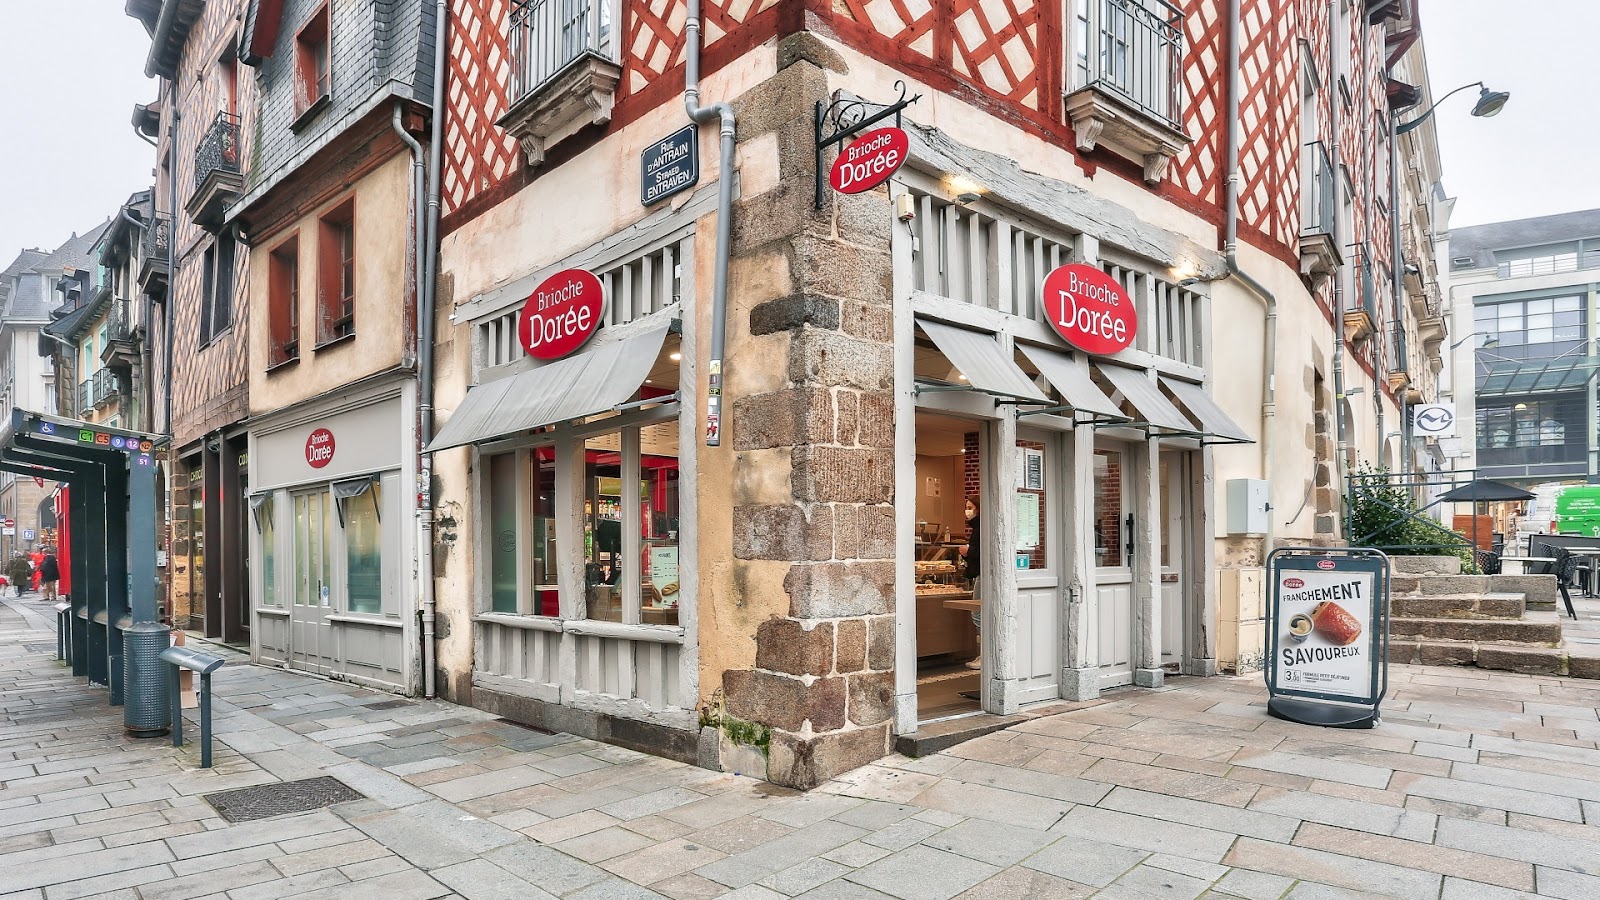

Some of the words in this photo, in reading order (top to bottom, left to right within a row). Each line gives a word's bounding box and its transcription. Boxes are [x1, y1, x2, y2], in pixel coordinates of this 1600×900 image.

[647, 142, 688, 172] D'ANTRAIN
[848, 133, 892, 162] Brioche
[647, 169, 690, 199] ENTRAVEN
[840, 149, 899, 190] Dorée
[538, 280, 584, 312] Brioche
[1069, 271, 1119, 307] Brioche
[529, 305, 591, 349] Dorée
[1059, 290, 1126, 343] Dorée
[81, 432, 92, 441] C1
[96, 435, 109, 444] C5
[115, 438, 121, 446] 9
[128, 440, 138, 448] 12
[312, 432, 329, 445] Brioche
[309, 445, 332, 462] Dorée
[1283, 581, 1361, 602] FRANCHEMENT
[1282, 647, 1360, 666] SAVOUREUX
[1285, 671, 1292, 681] 3
